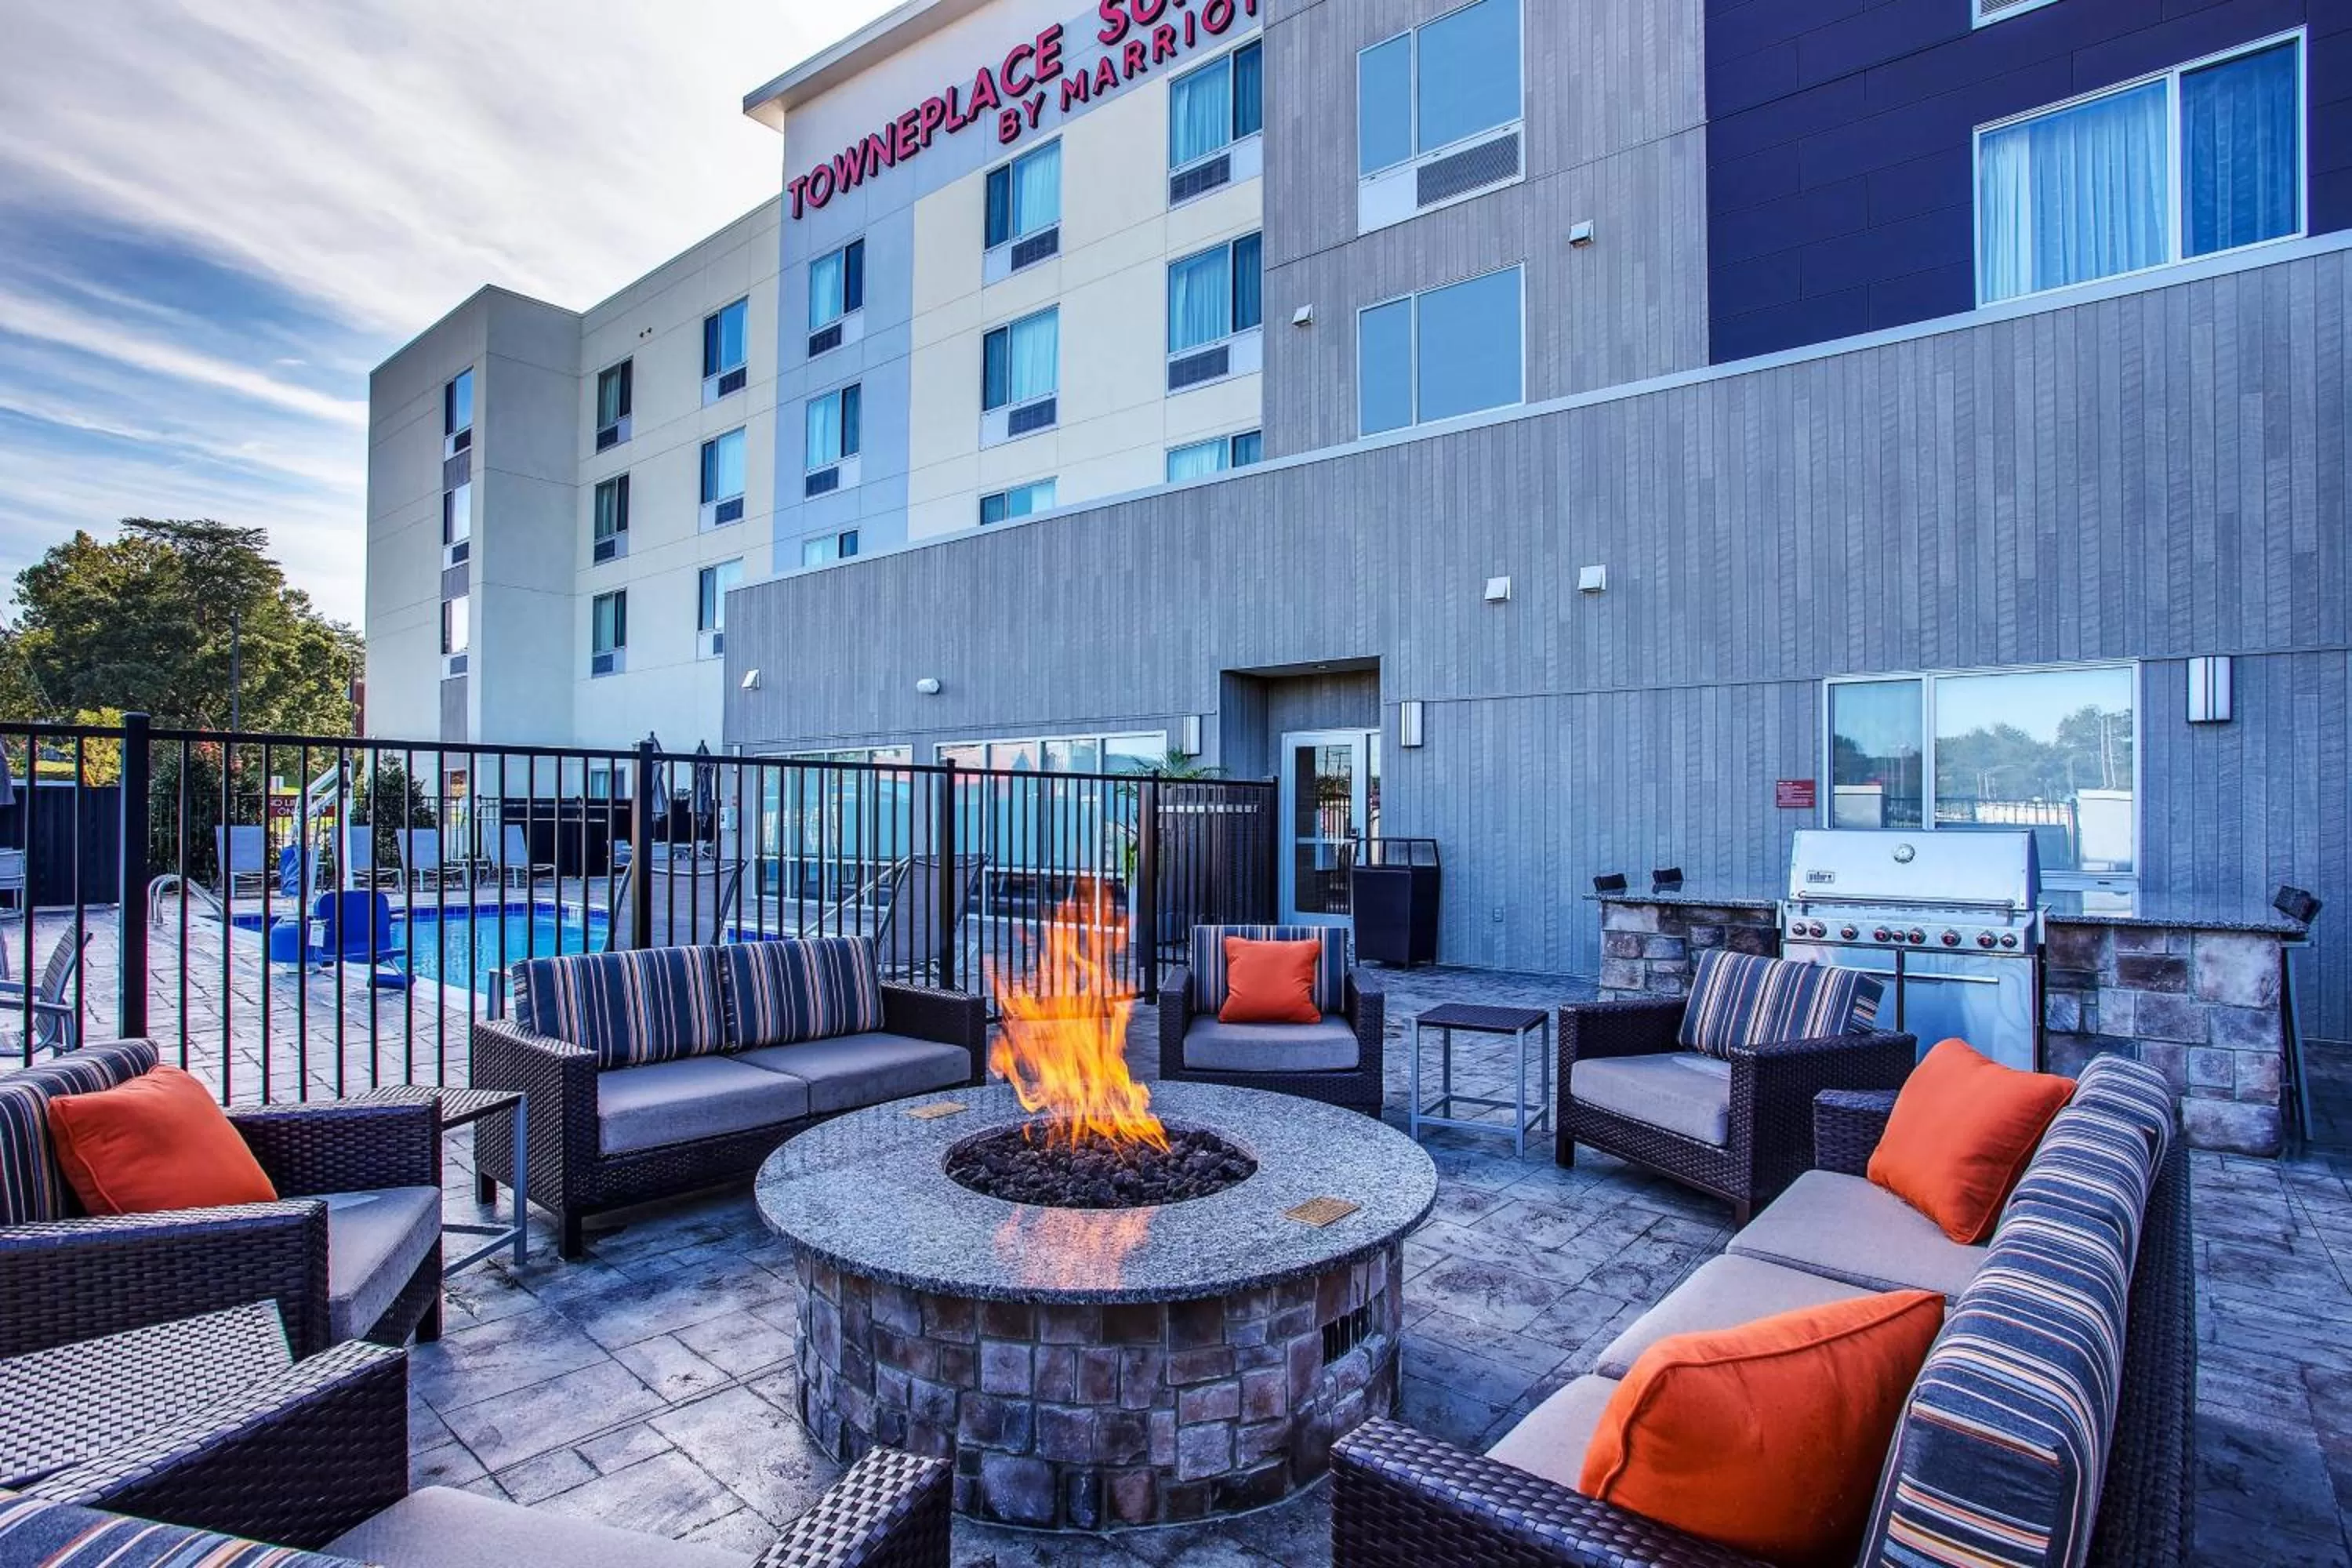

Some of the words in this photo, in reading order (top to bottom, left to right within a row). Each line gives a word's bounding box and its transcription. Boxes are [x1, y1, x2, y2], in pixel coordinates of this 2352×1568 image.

[788, 23, 1063, 220] TOWNEPLACE
[998, 91, 1046, 144] BY
[1061, 0, 1256, 112] MARRIO
